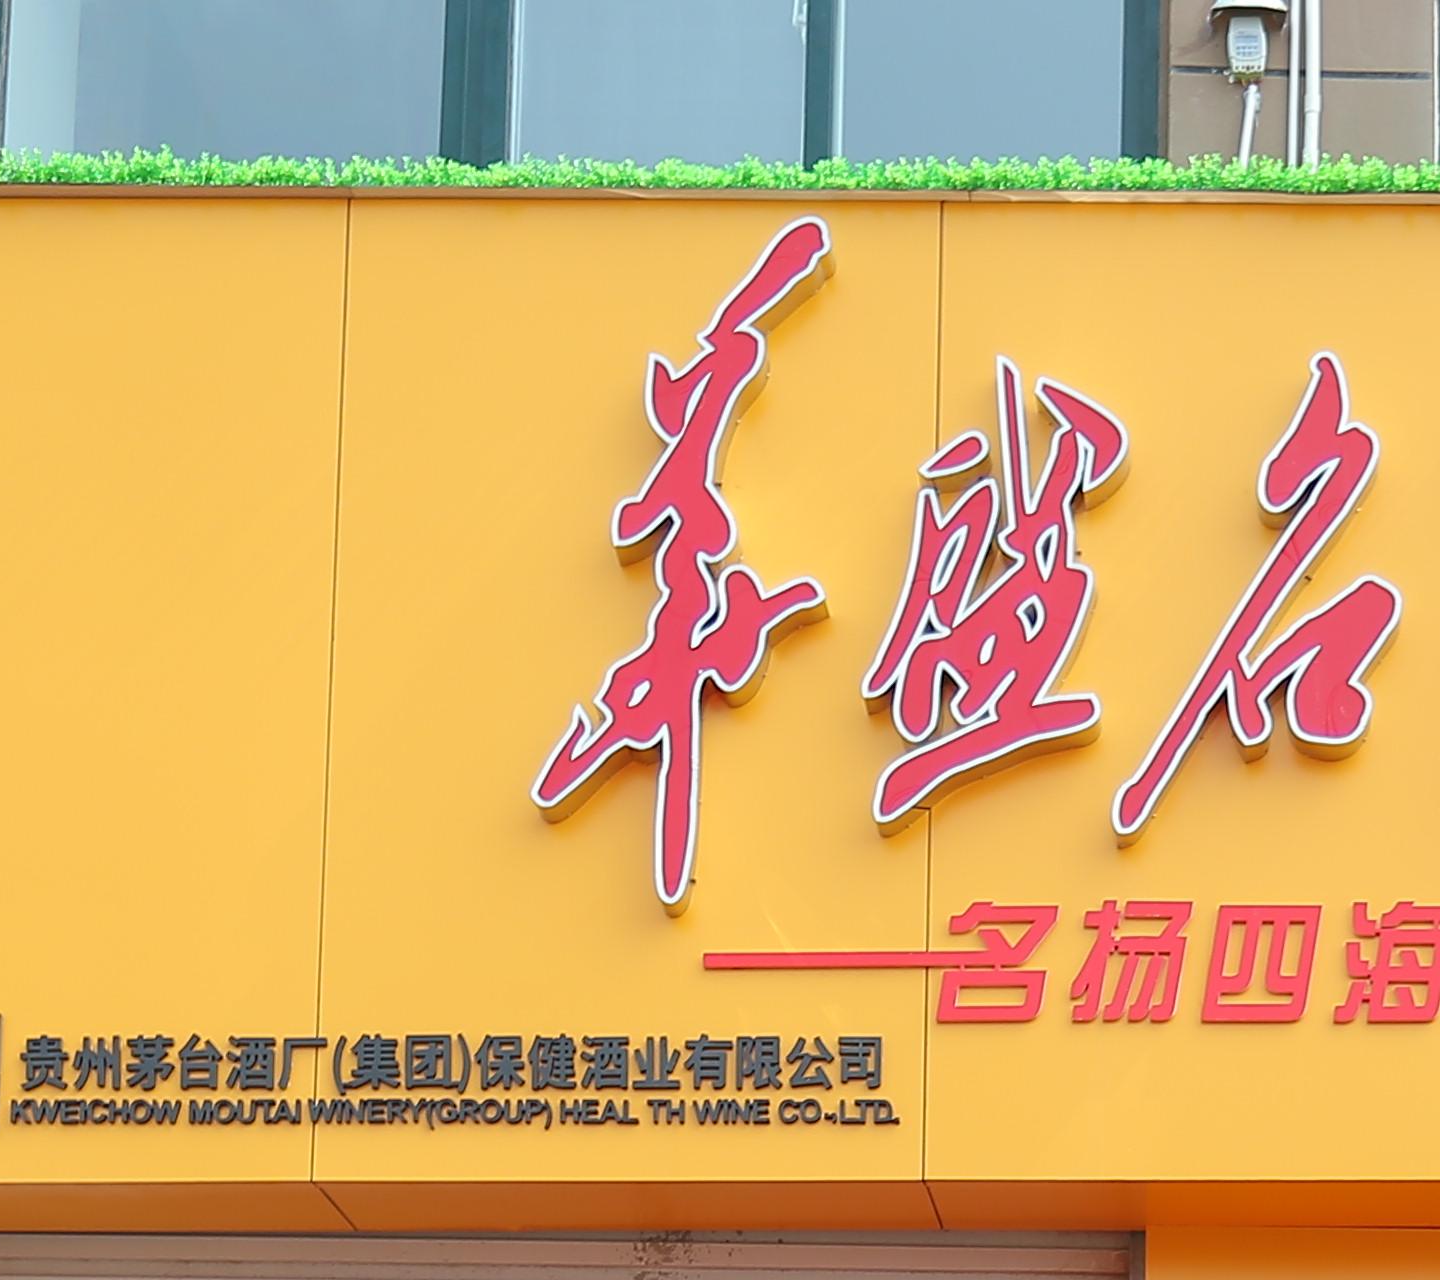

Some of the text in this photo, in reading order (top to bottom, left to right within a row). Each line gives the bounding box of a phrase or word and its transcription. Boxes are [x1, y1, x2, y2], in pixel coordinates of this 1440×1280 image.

[21, 1034, 882, 1094] 贵州茅台酒厂(集团)保健酒业有限公司
[11, 1099, 180, 1124] KWEICHOW
[189, 1099, 302, 1124] MOUTAI
[561, 1099, 639, 1124] HEAL
[693, 1099, 770, 1124] WINE
